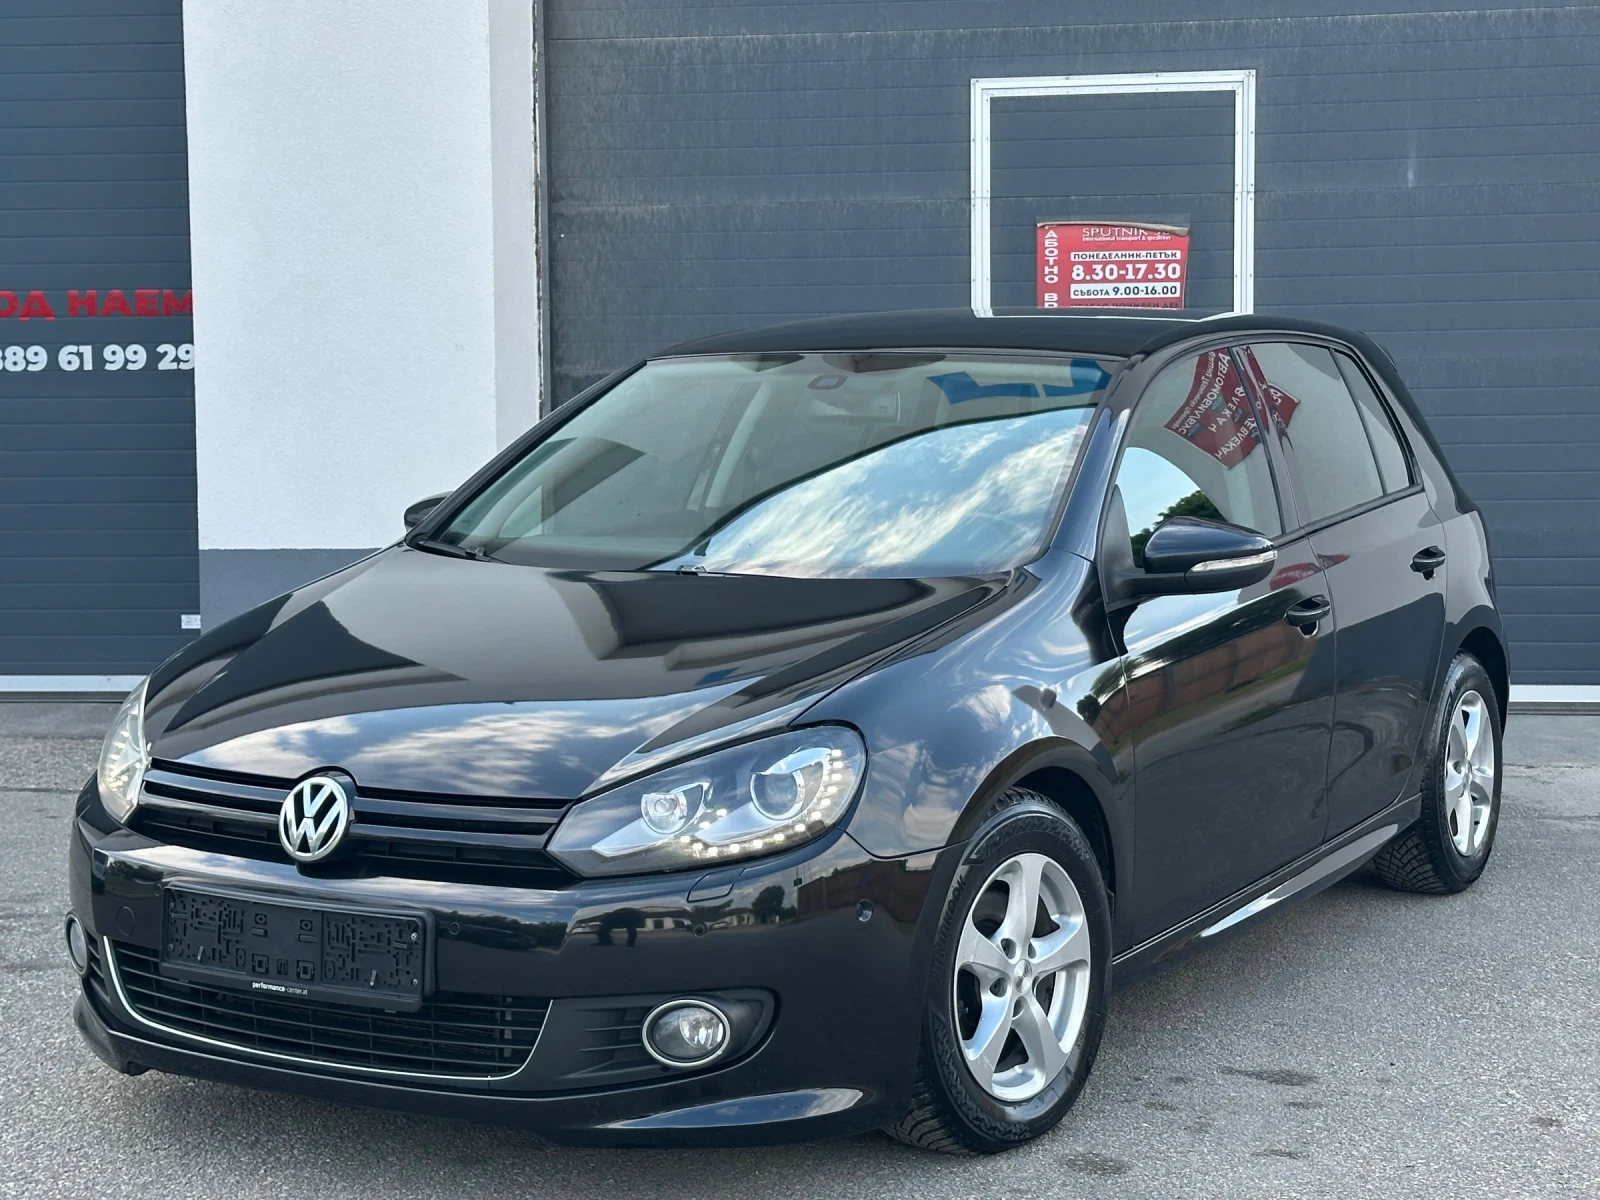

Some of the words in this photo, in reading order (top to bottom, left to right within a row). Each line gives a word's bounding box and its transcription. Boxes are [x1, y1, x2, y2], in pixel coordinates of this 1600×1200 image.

[1082, 227, 1149, 237] SPUTNIK
[1044, 226, 1059, 284] АБОТНО
[1073, 251, 1178, 261] ПОНЕДЕЛНИК-ПЕТЪК
[1071, 262, 1181, 281] 8.30-17.30
[1072, 289, 1111, 297] СЪБОТА
[1112, 285, 1178, 296] 9.00-16.00
[0, 344, 48, 372] 89
[57, 344, 93, 372] 61
[102, 343, 148, 371] 99
[155, 343, 195, 371] 29
[281, 777, 348, 860] VW
